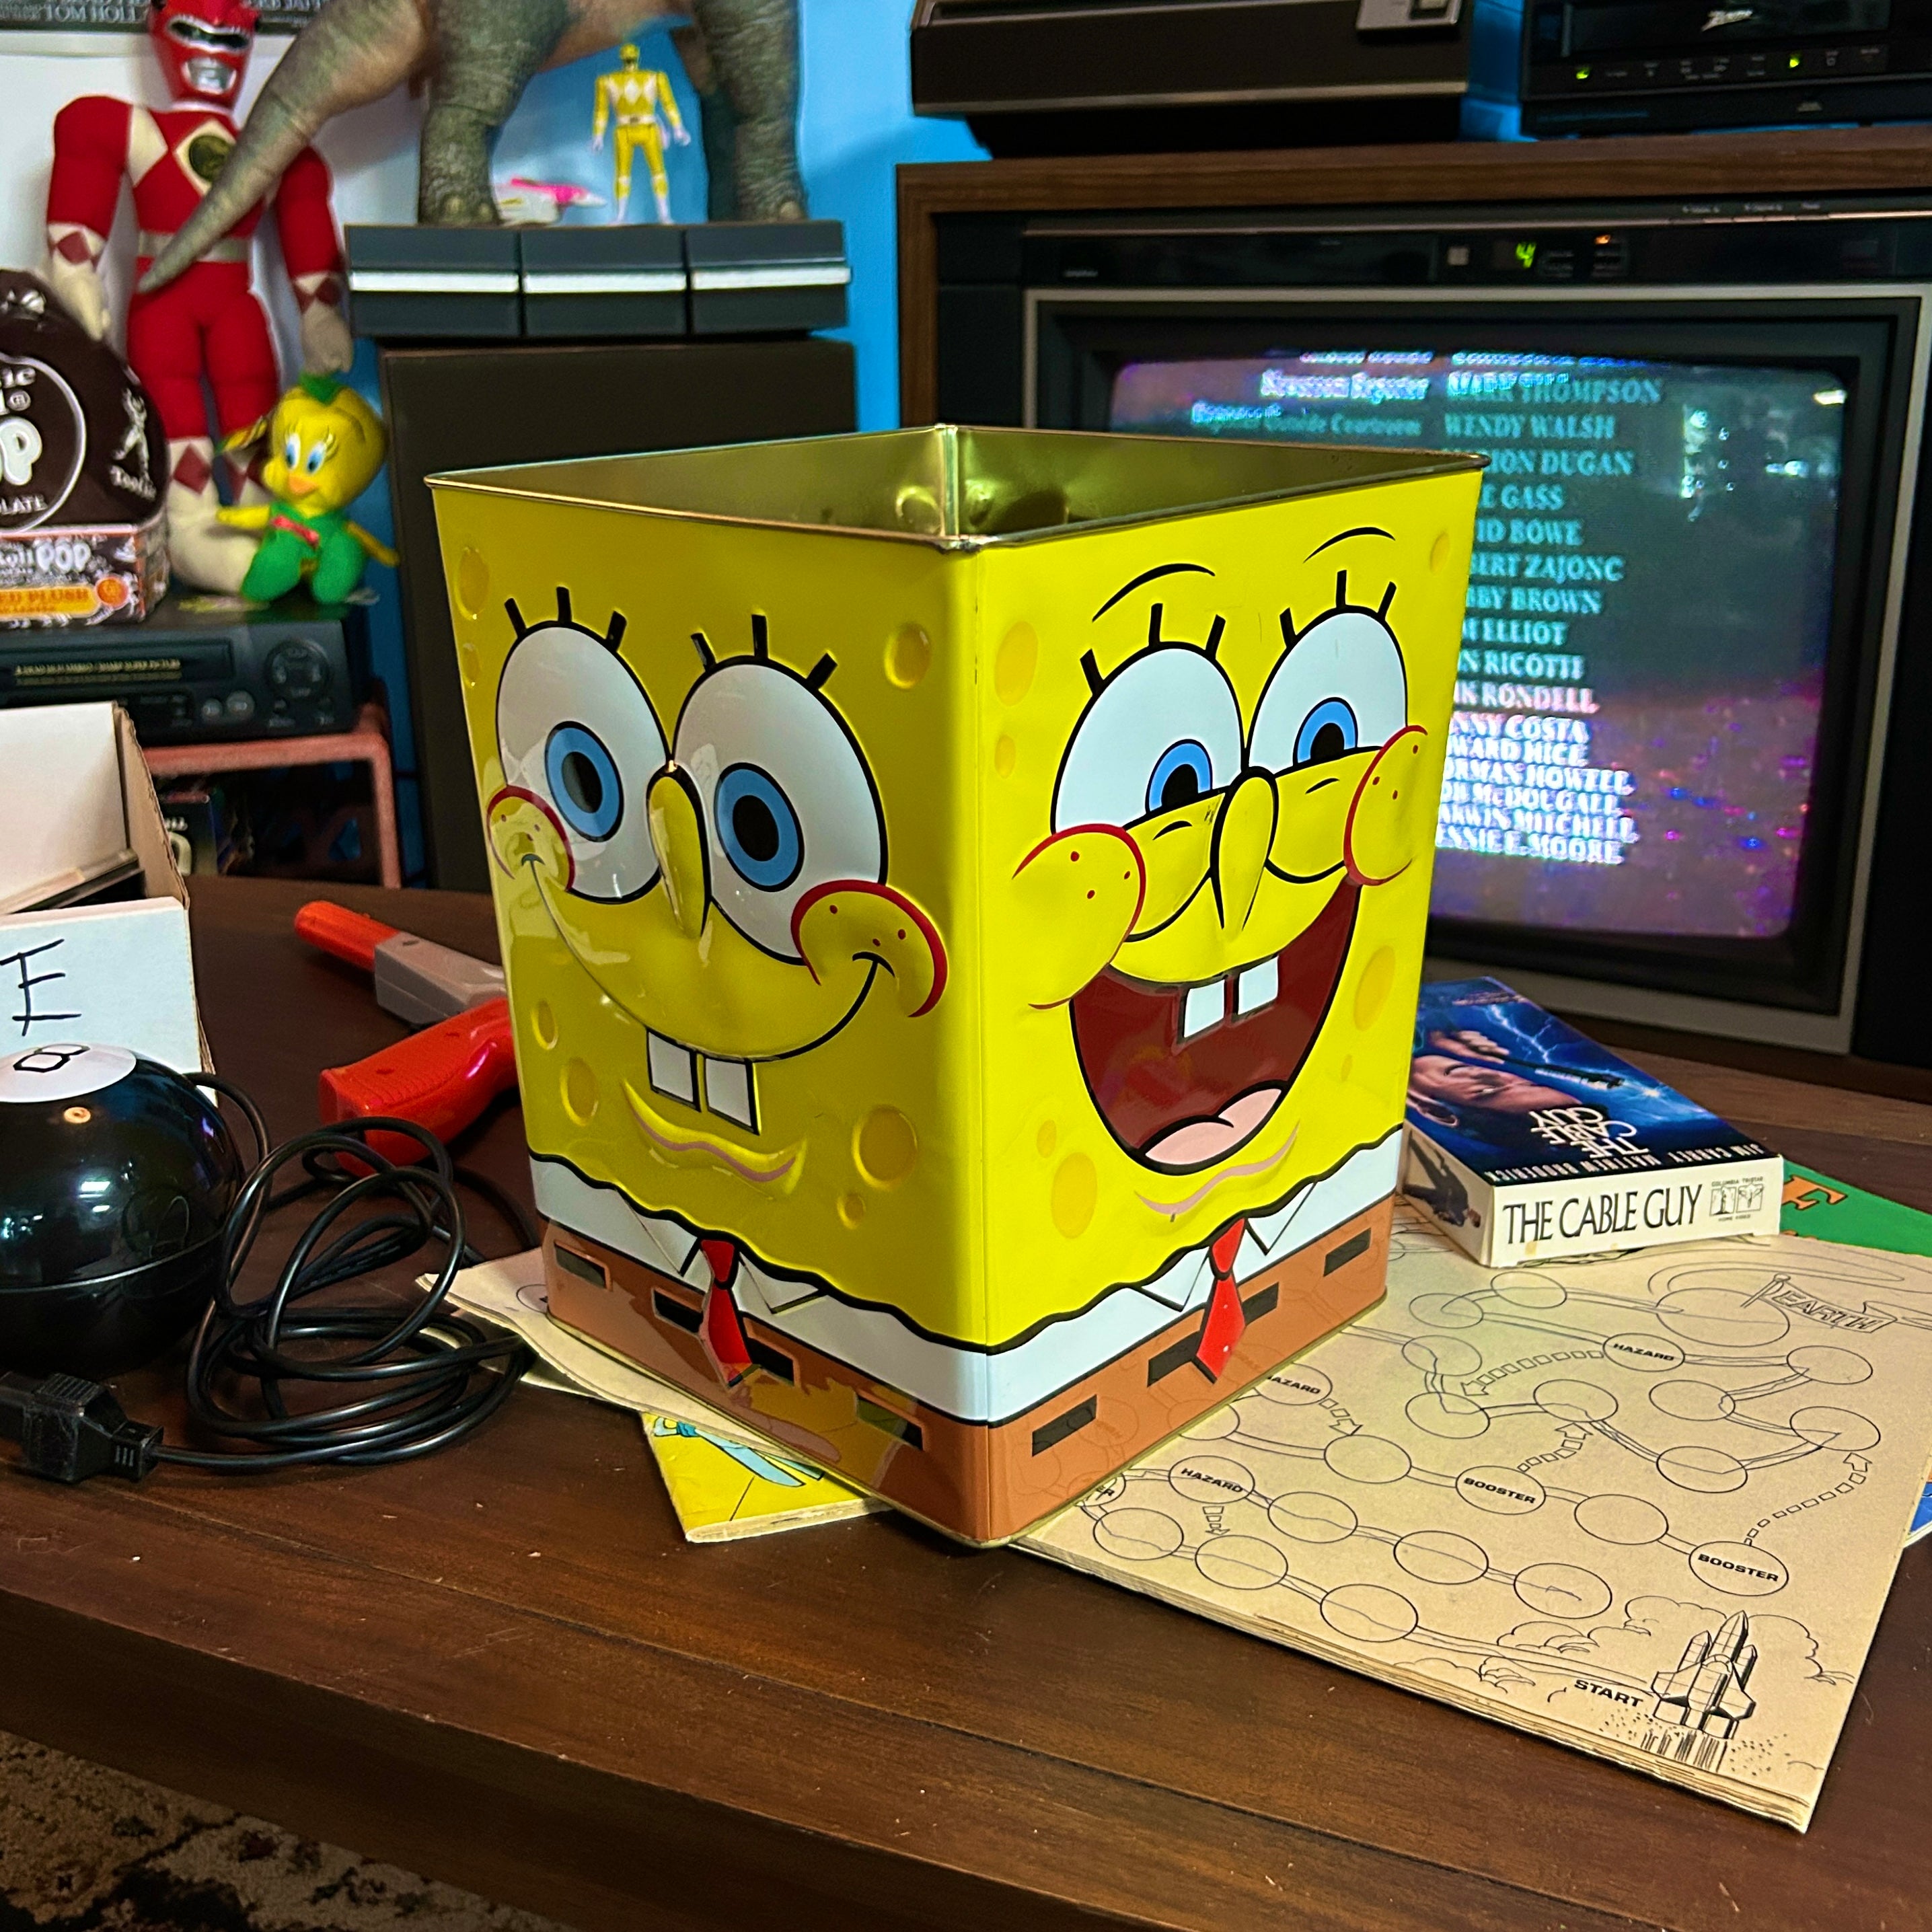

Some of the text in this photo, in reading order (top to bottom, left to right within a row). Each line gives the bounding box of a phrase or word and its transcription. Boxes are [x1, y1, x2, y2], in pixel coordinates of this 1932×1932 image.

[1516, 241, 1537, 268] 4
[1446, 412, 1525, 439] WENDY
[1530, 412, 1616, 440] WALSH
[1540, 447, 1635, 476] DUGAN
[1500, 484, 1566, 511] GASS
[1510, 517, 1584, 546] BOWE
[35, 540, 91, 572] POP
[1524, 554, 1627, 584] ZAJONC
[1511, 586, 1605, 614] BROWN
[1482, 617, 1570, 646] ELLIOT
[1482, 681, 1600, 714] RONDELL
[1504, 714, 1590, 743] COSTA
[1513, 809, 1640, 844] MITCHELL
[1528, 832, 1625, 865] MOORE
[13, 1043, 90, 1073] 8
[1528, 1107, 1604, 1129] GUY
[1530, 1120, 1637, 1145] CABLE
[1569, 1136, 1649, 1159] THE
[1484, 1143, 1765, 1182] JIM CARREY MATTHEW BRODERICK
[1711, 1179, 1740, 1187] COLUMBIA
[1502, 1184, 1703, 1244] THE CABLE GUY
[1771, 1290, 1884, 1329] EARTH
[1612, 1343, 1675, 1362] HAZARD
[1181, 1467, 1244, 1494] HAZARD
[1463, 1477, 1536, 1504] BOOSTER
[1697, 1553, 1779, 1582] BOOSTER
[1573, 1678, 1644, 1707] START
